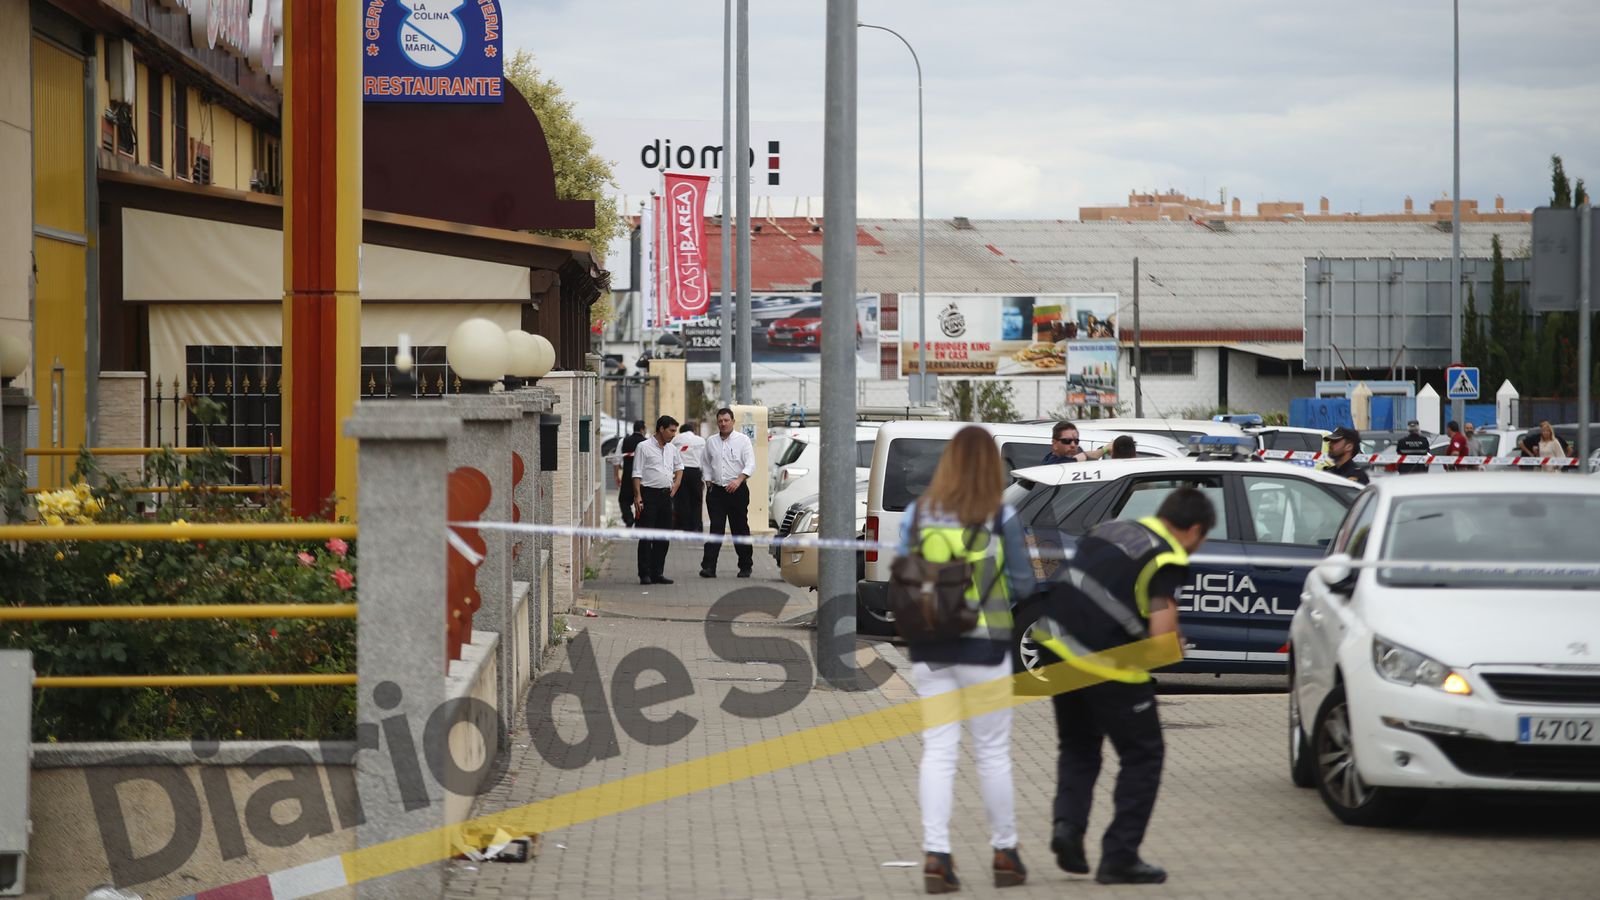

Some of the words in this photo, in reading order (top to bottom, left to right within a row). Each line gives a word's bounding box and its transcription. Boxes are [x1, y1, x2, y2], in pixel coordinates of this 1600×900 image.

[413, 3, 426, 11] LA
[413, 12, 449, 20] COLINA
[405, 34, 418, 42] DE
[405, 44, 436, 52] MARIA
[364, 76, 501, 96] RESTAURANTE
[934, 342, 967, 351] BURGER
[970, 342, 991, 351] KING
[1071, 470, 1101, 481] 2L1
[1176, 594, 1297, 615] CIONAL
[1535, 720, 1594, 741] 4702
